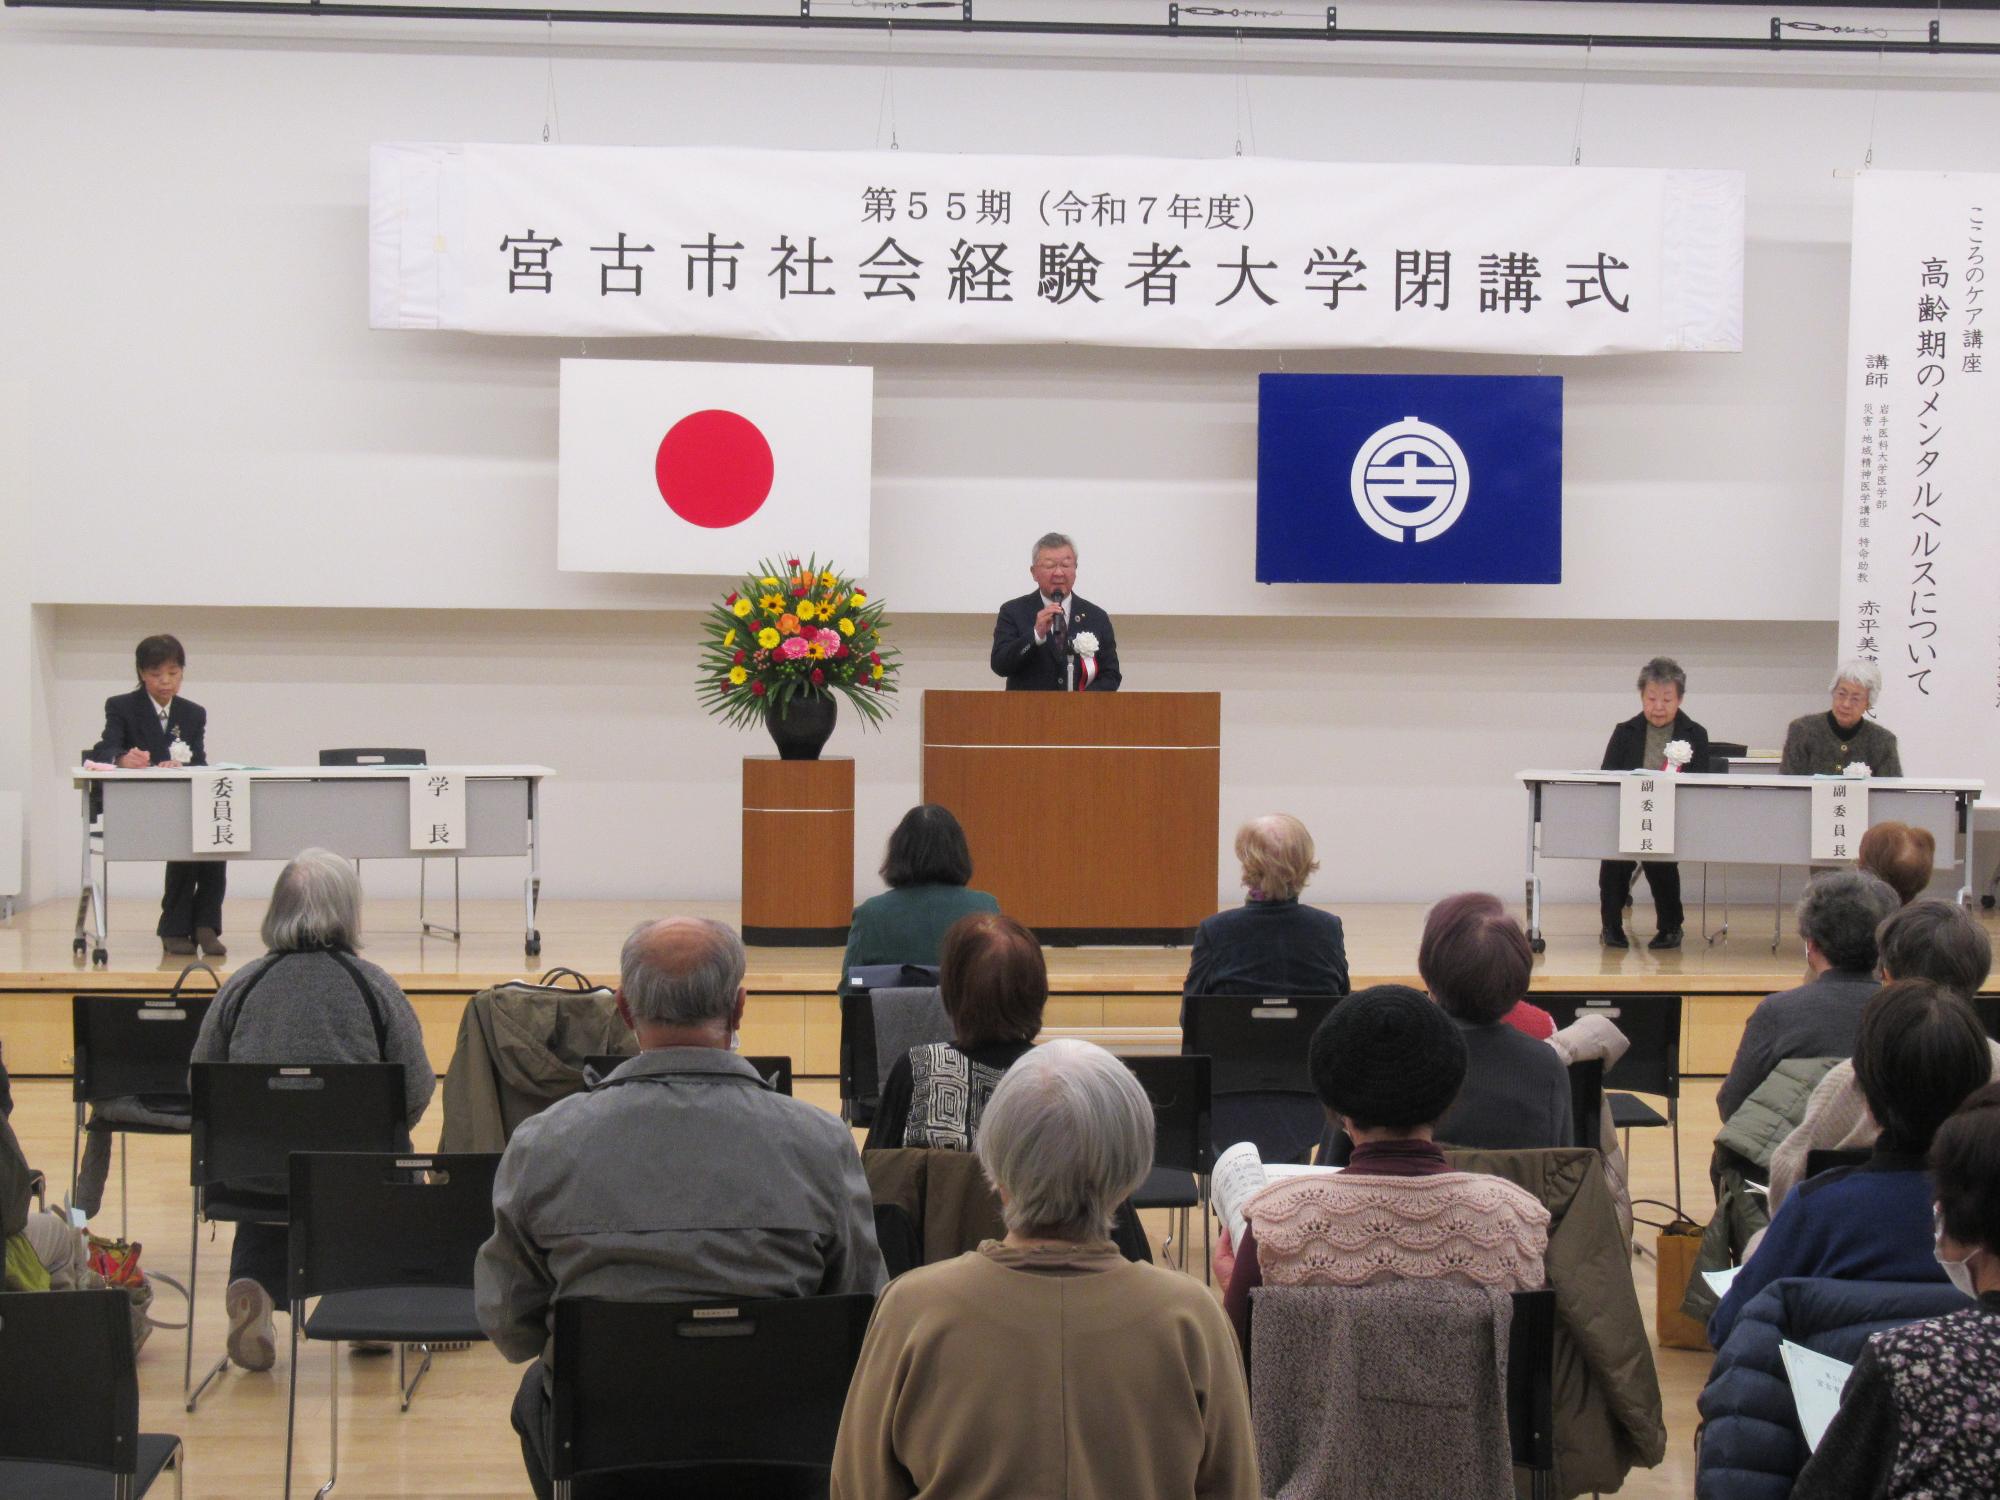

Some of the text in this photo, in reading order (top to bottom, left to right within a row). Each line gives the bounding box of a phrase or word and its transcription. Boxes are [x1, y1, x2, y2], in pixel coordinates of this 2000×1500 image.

[499, 226, 1630, 315] 宮古市社会経験者大学閉講式
[1962, 206, 1985, 374] こころのケア講座
[1864, 353, 1890, 389] 講師
[1904, 256, 1951, 697] 高齢期のメンタルヘルスについて
[211, 776, 234, 846] 委員長
[427, 775, 450, 845] 学長
[1640, 779, 1655, 851] 副委員長
[1832, 784, 1847, 857] 副委員長
